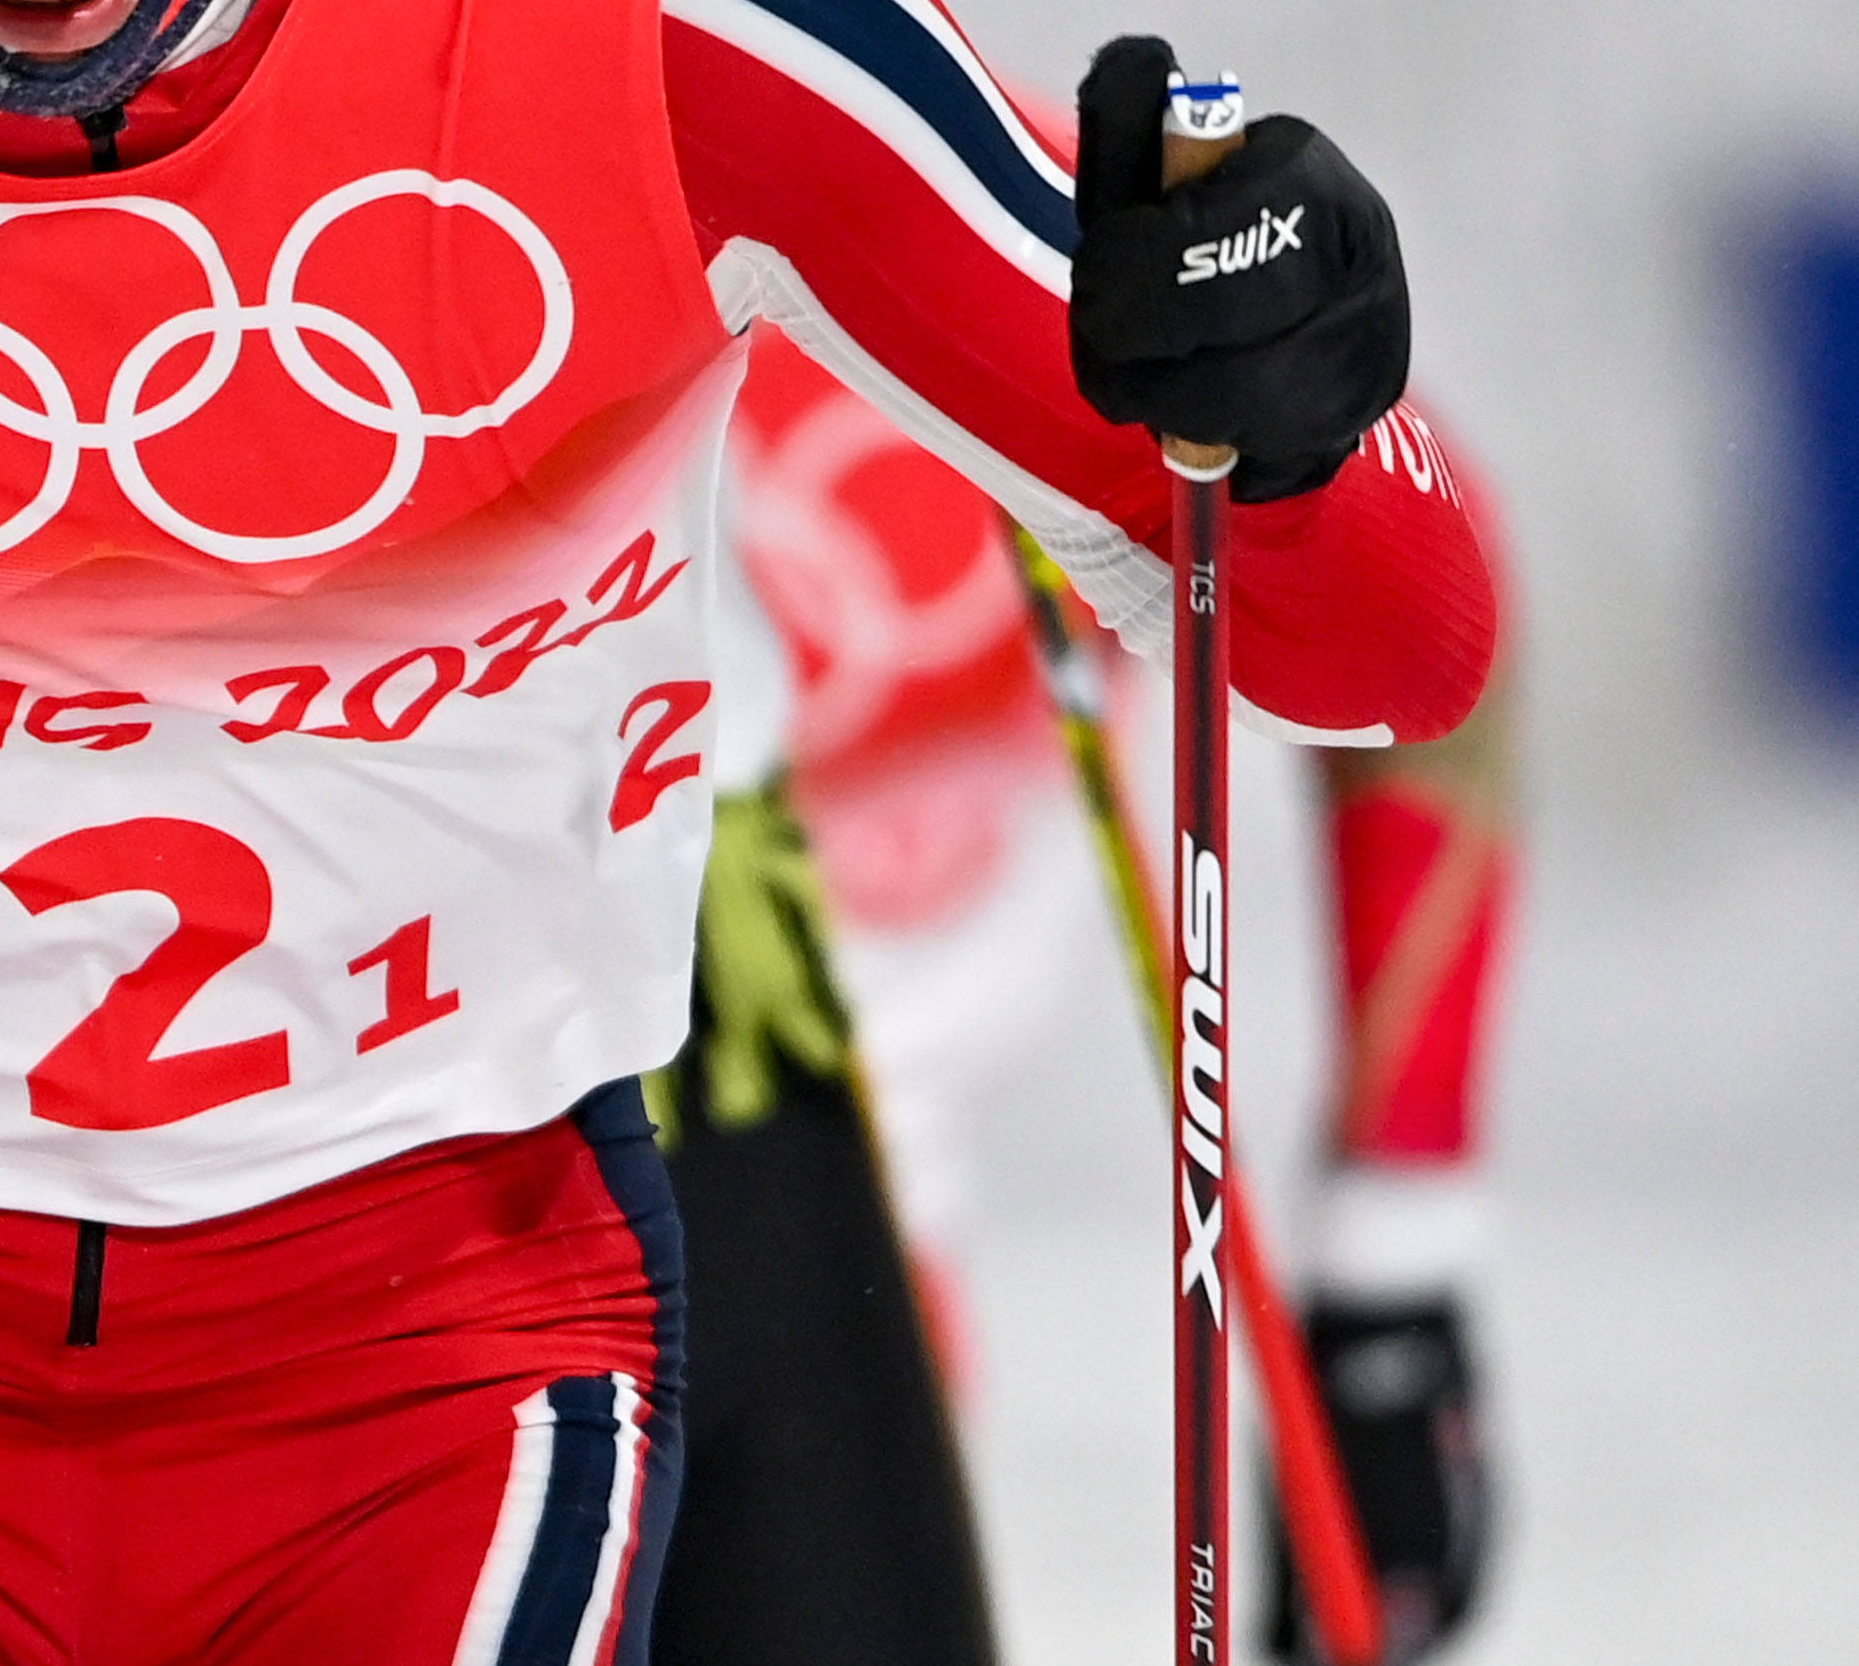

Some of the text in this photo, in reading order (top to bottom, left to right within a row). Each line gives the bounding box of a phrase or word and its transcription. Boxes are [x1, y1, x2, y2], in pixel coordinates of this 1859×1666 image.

[1177, 205, 1304, 285] swix
[220, 528, 690, 743] 2022
[1189, 559, 1215, 615] TCS
[608, 680, 712, 834] 2
[346, 913, 461, 1055] 1
[1190, 1543, 1216, 1663] TRIAC
